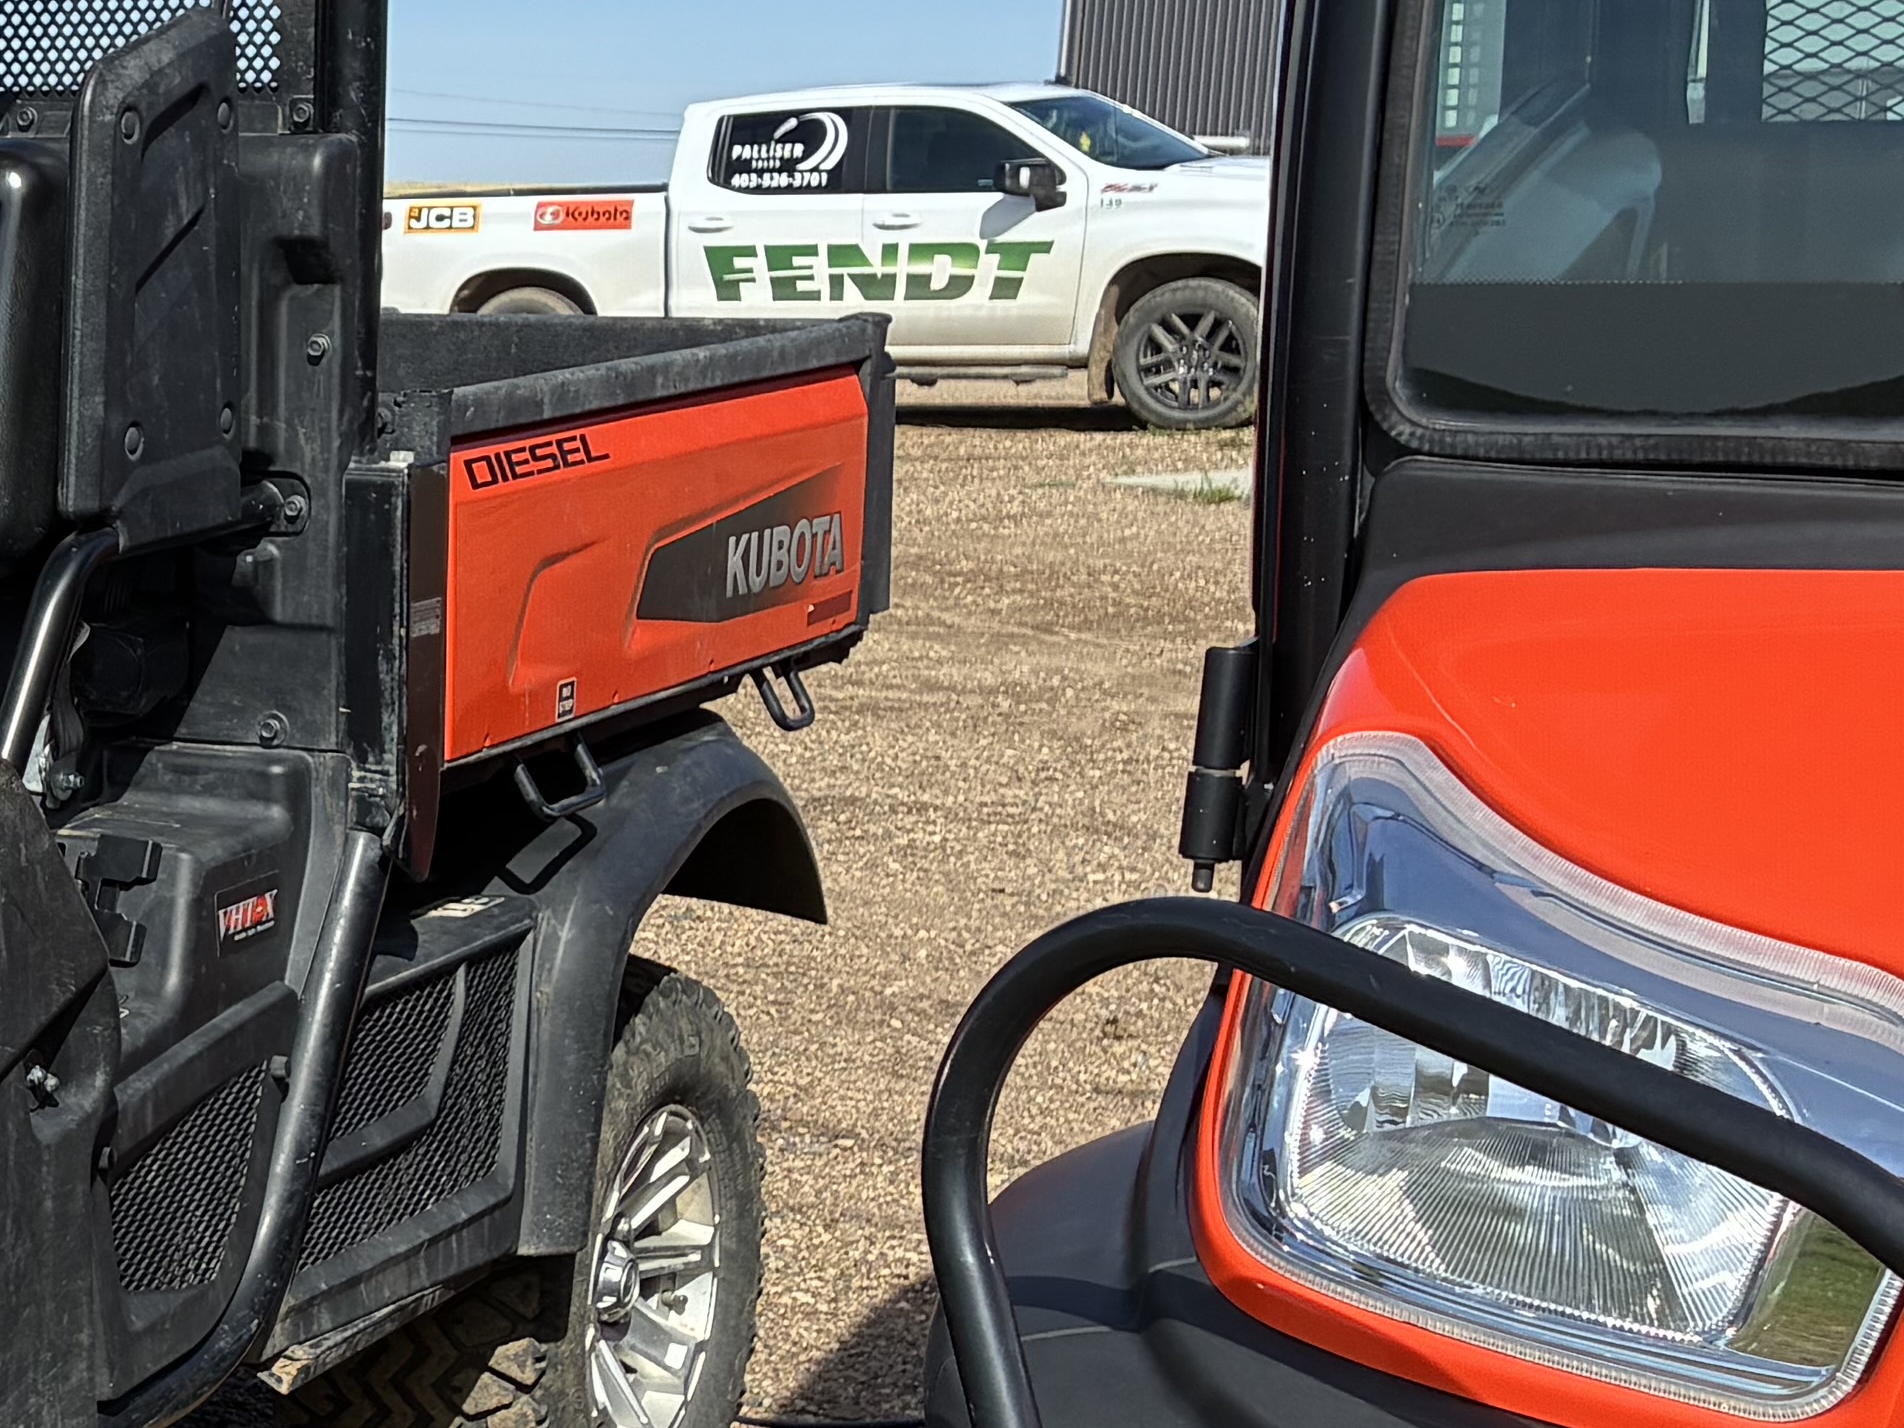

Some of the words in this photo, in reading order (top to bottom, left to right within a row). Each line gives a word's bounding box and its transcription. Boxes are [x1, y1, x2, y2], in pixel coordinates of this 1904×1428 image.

[731, 140, 805, 160] PALLISER
[409, 207, 475, 229] JCB
[565, 201, 630, 223] Kubota
[703, 240, 1055, 302] FENDT
[463, 433, 611, 491] DIESEL
[725, 511, 844, 599] KUBOTA
